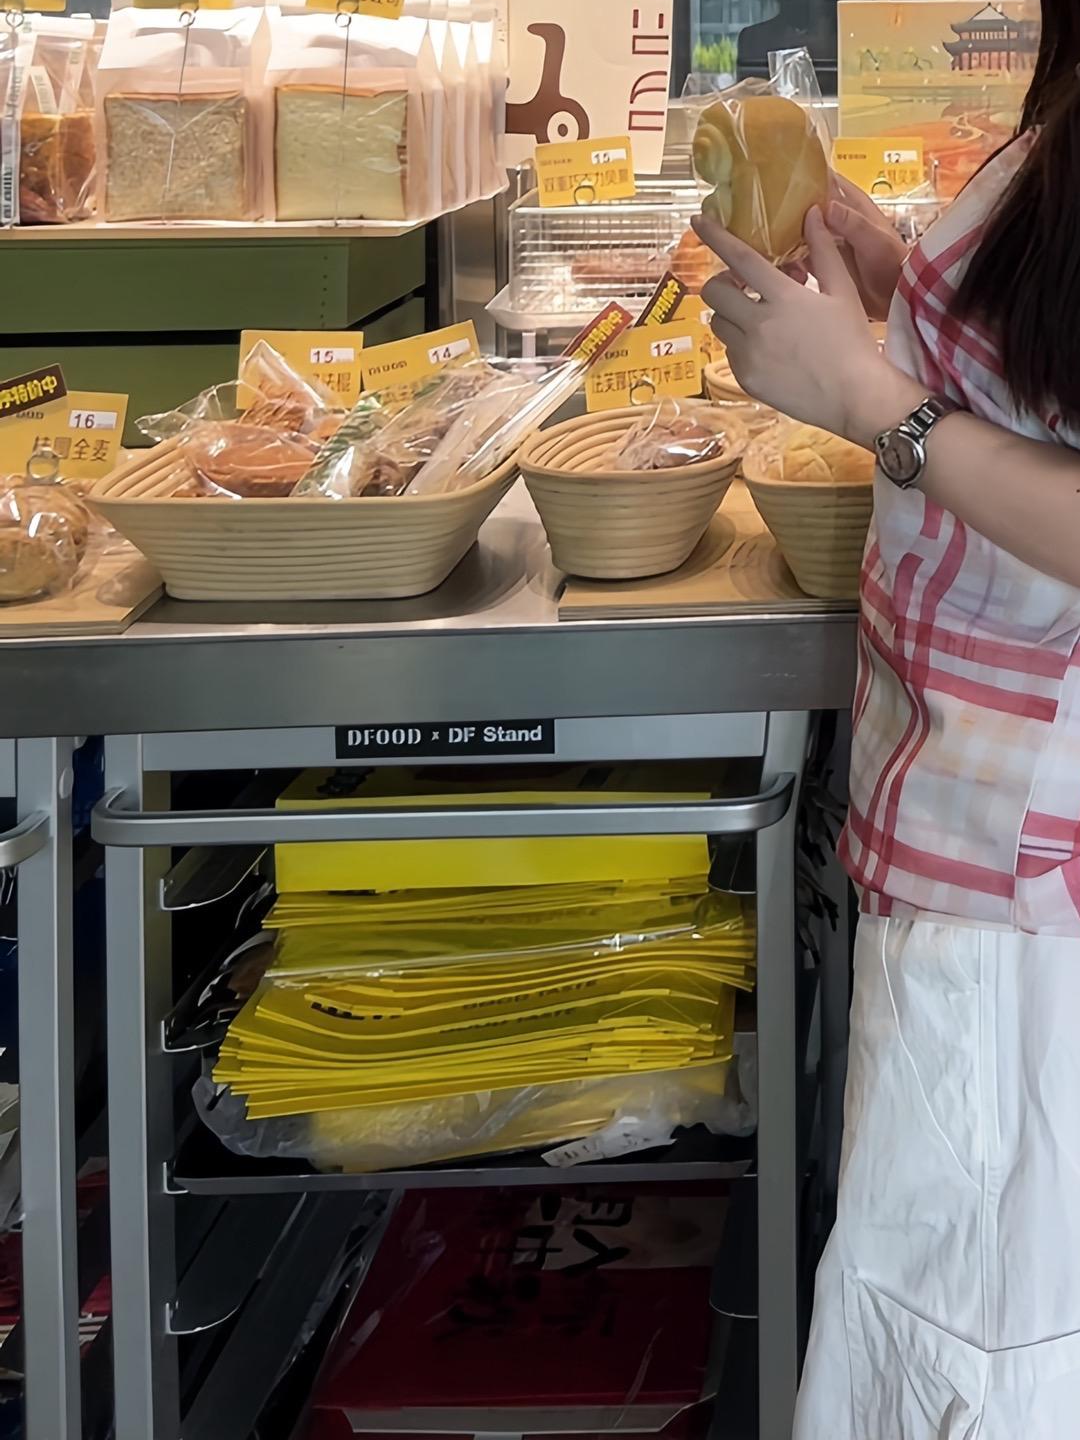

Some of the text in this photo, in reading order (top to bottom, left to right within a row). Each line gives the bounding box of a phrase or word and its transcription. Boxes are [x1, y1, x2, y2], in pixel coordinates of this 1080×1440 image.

[653, 342, 674, 357] 12
[74, 414, 95, 429] 16
[347, 728, 422, 746] DFOOD
[448, 726, 476, 744] DF
[483, 725, 543, 743] Stand
